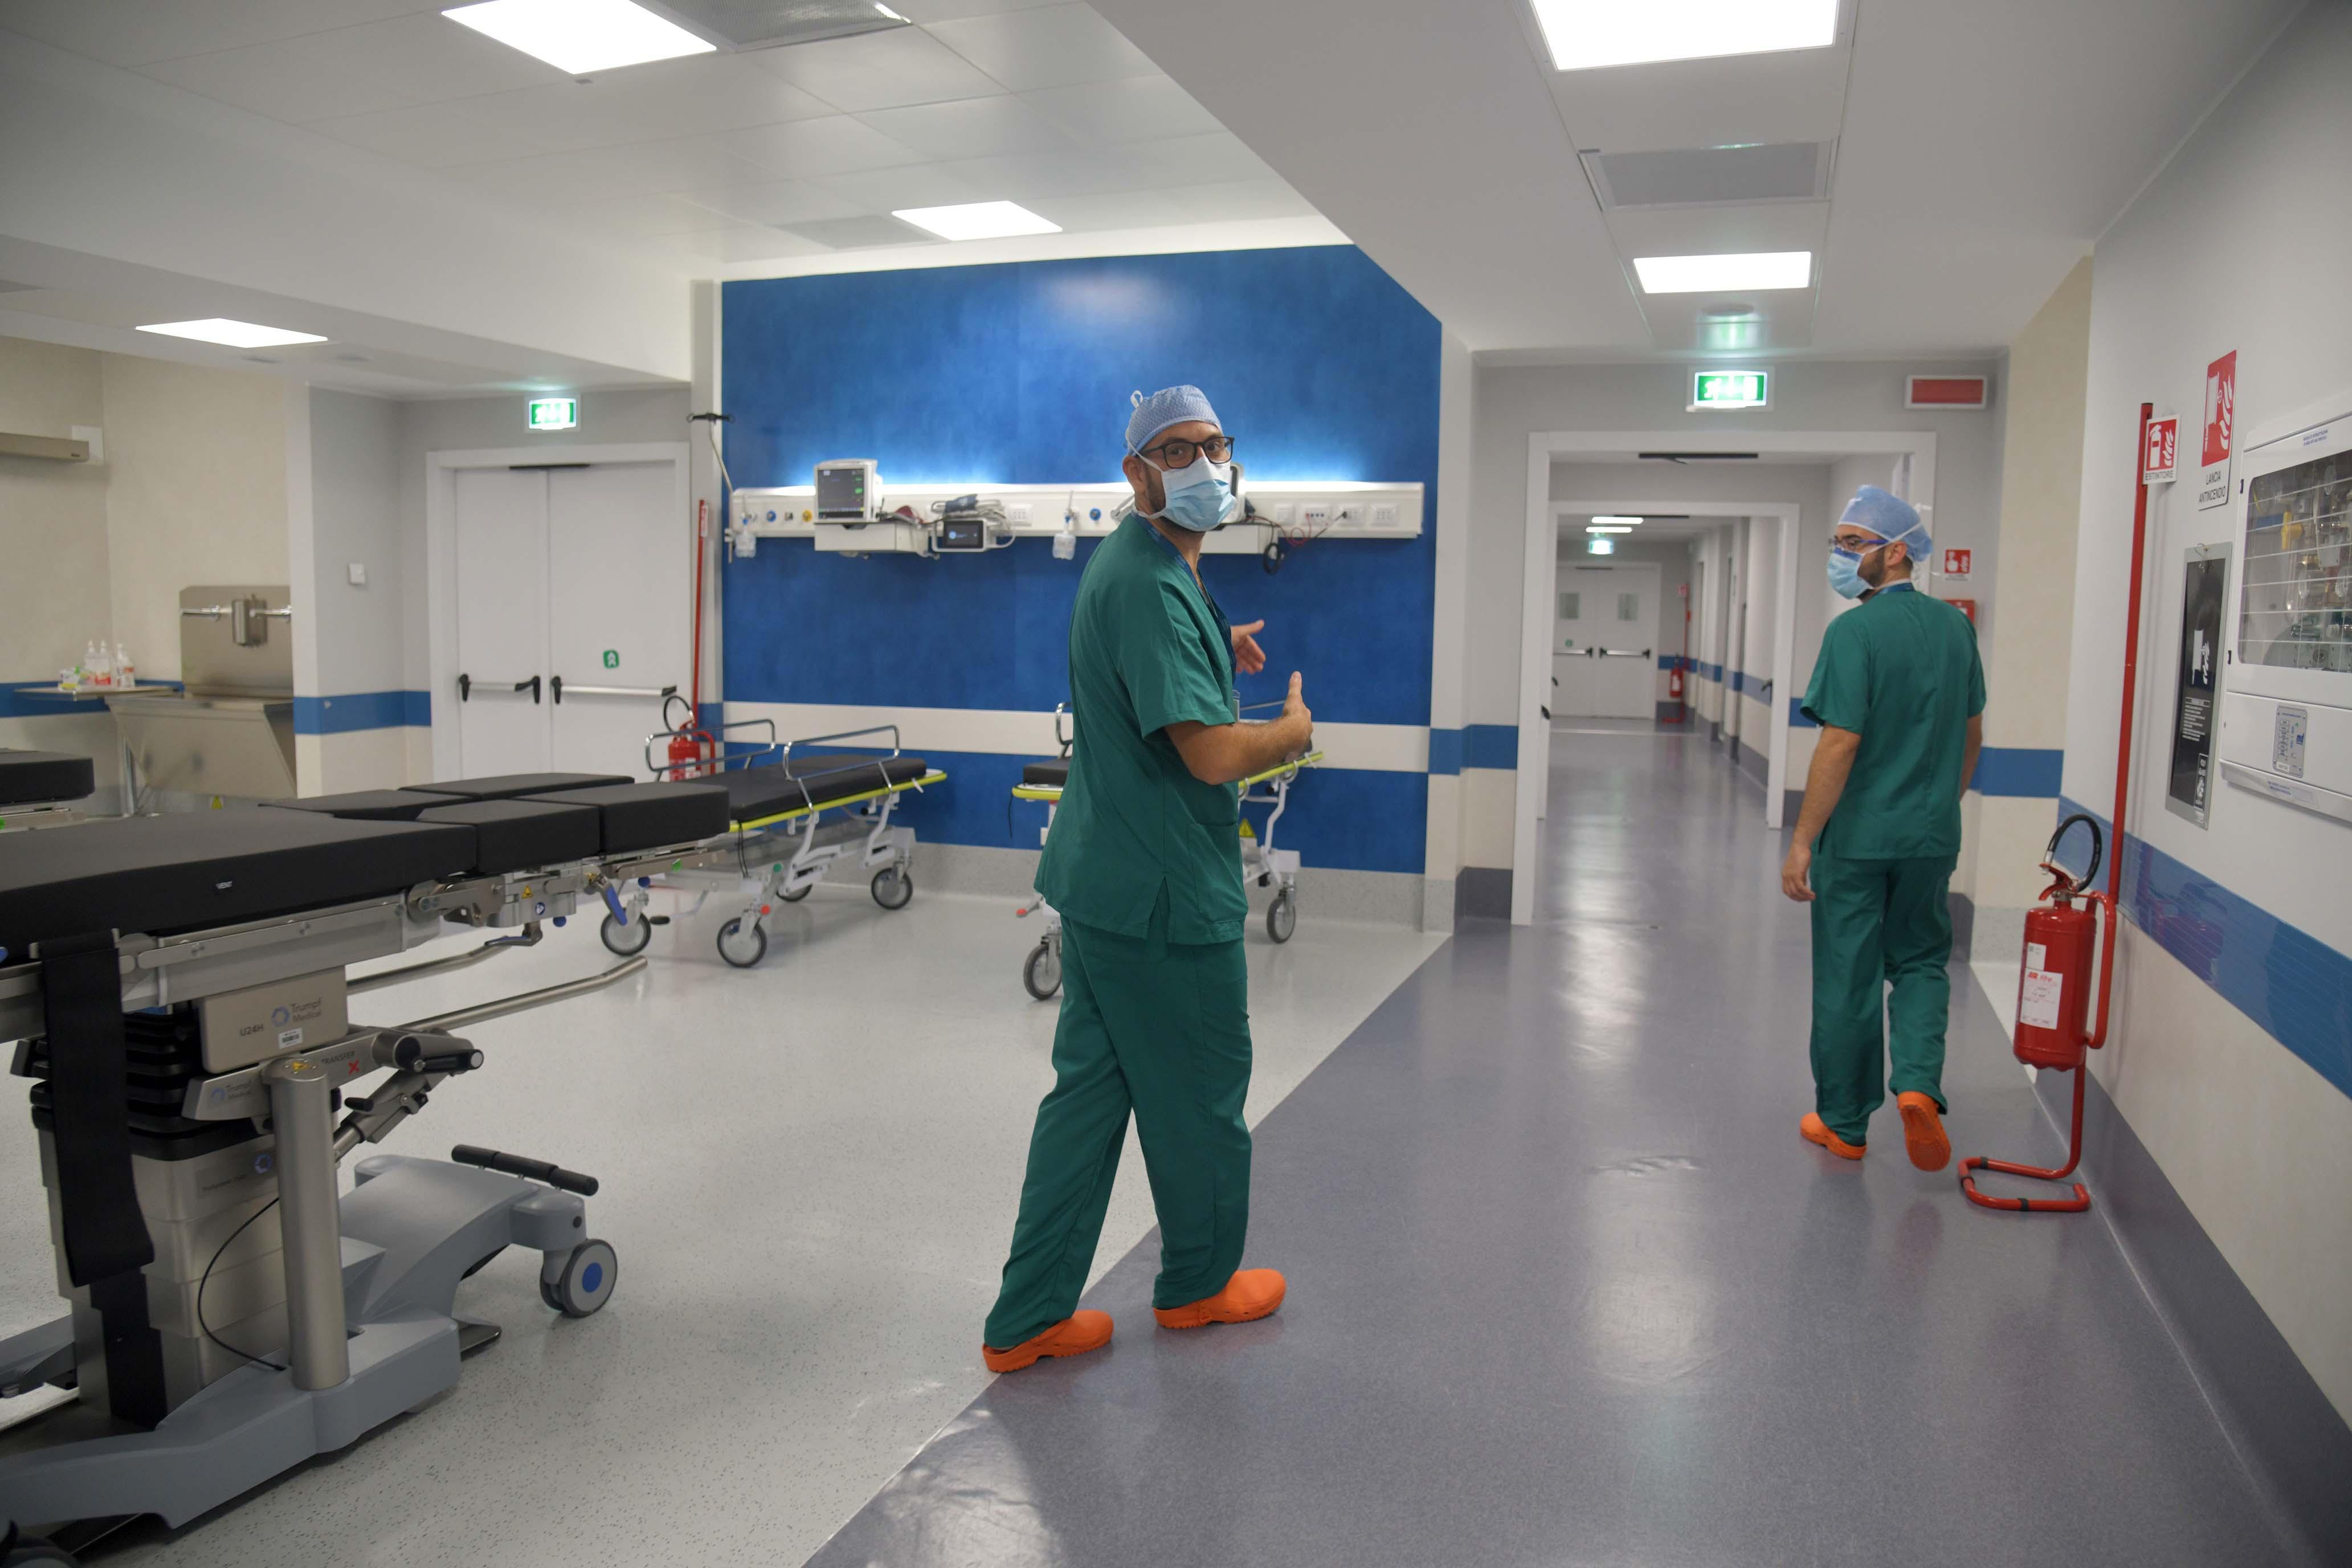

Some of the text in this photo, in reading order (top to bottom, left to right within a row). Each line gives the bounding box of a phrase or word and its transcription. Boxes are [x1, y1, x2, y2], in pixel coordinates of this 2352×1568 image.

[2145, 471, 2173, 480] ESTINTORE
[2206, 471, 2220, 485] LANCIA
[2199, 486, 2226, 502] ANTINCENDIO
[292, 997, 321, 1012] Trumpf
[292, 1011, 321, 1022] Medical
[240, 1024, 264, 1036] U24H
[321, 1051, 354, 1064] TRANSFER
